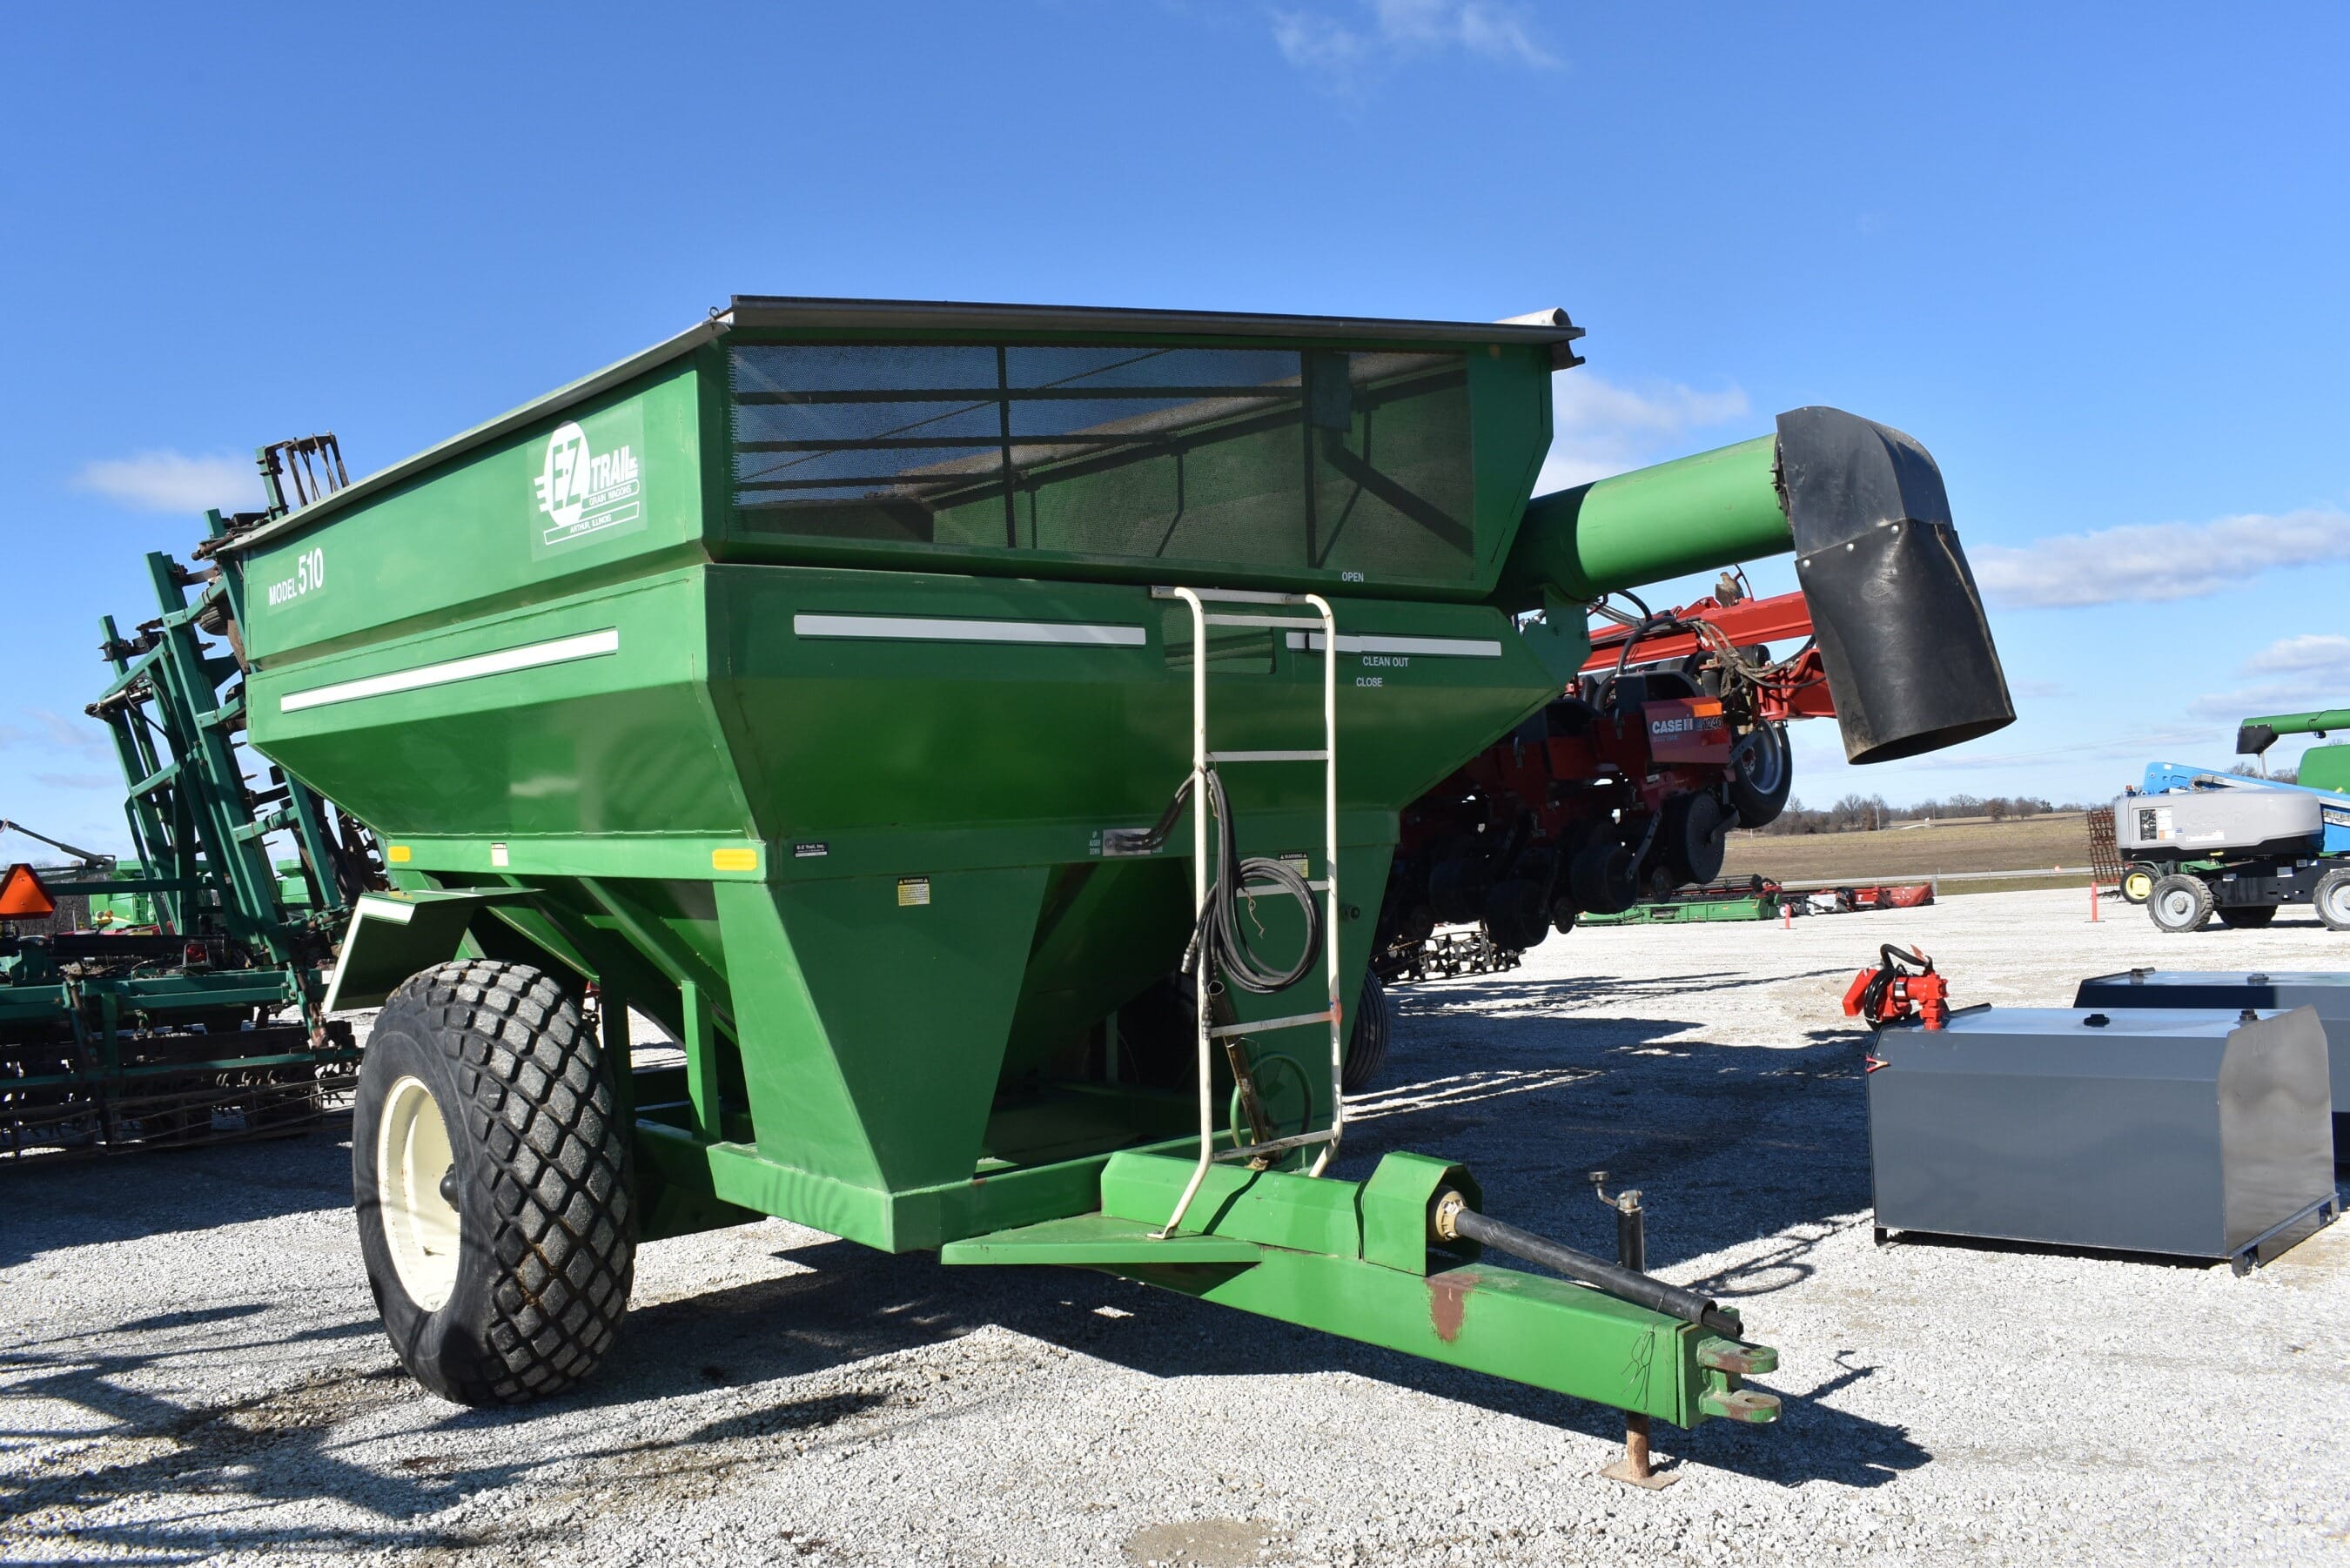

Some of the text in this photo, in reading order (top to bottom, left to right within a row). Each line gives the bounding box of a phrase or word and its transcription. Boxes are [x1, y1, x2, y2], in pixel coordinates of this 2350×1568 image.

[591, 445, 638, 492] TRAIL
[588, 485, 632, 506] GRAIN WAGONS
[592, 513, 612, 527] ILLINOIS
[269, 547, 324, 606] MODEL 510
[1342, 572, 1364, 582] OPEN
[1363, 656, 1409, 667] CLEAN OUT
[1356, 677, 1382, 687] CLOSE
[1652, 719, 1682, 734] CASE
